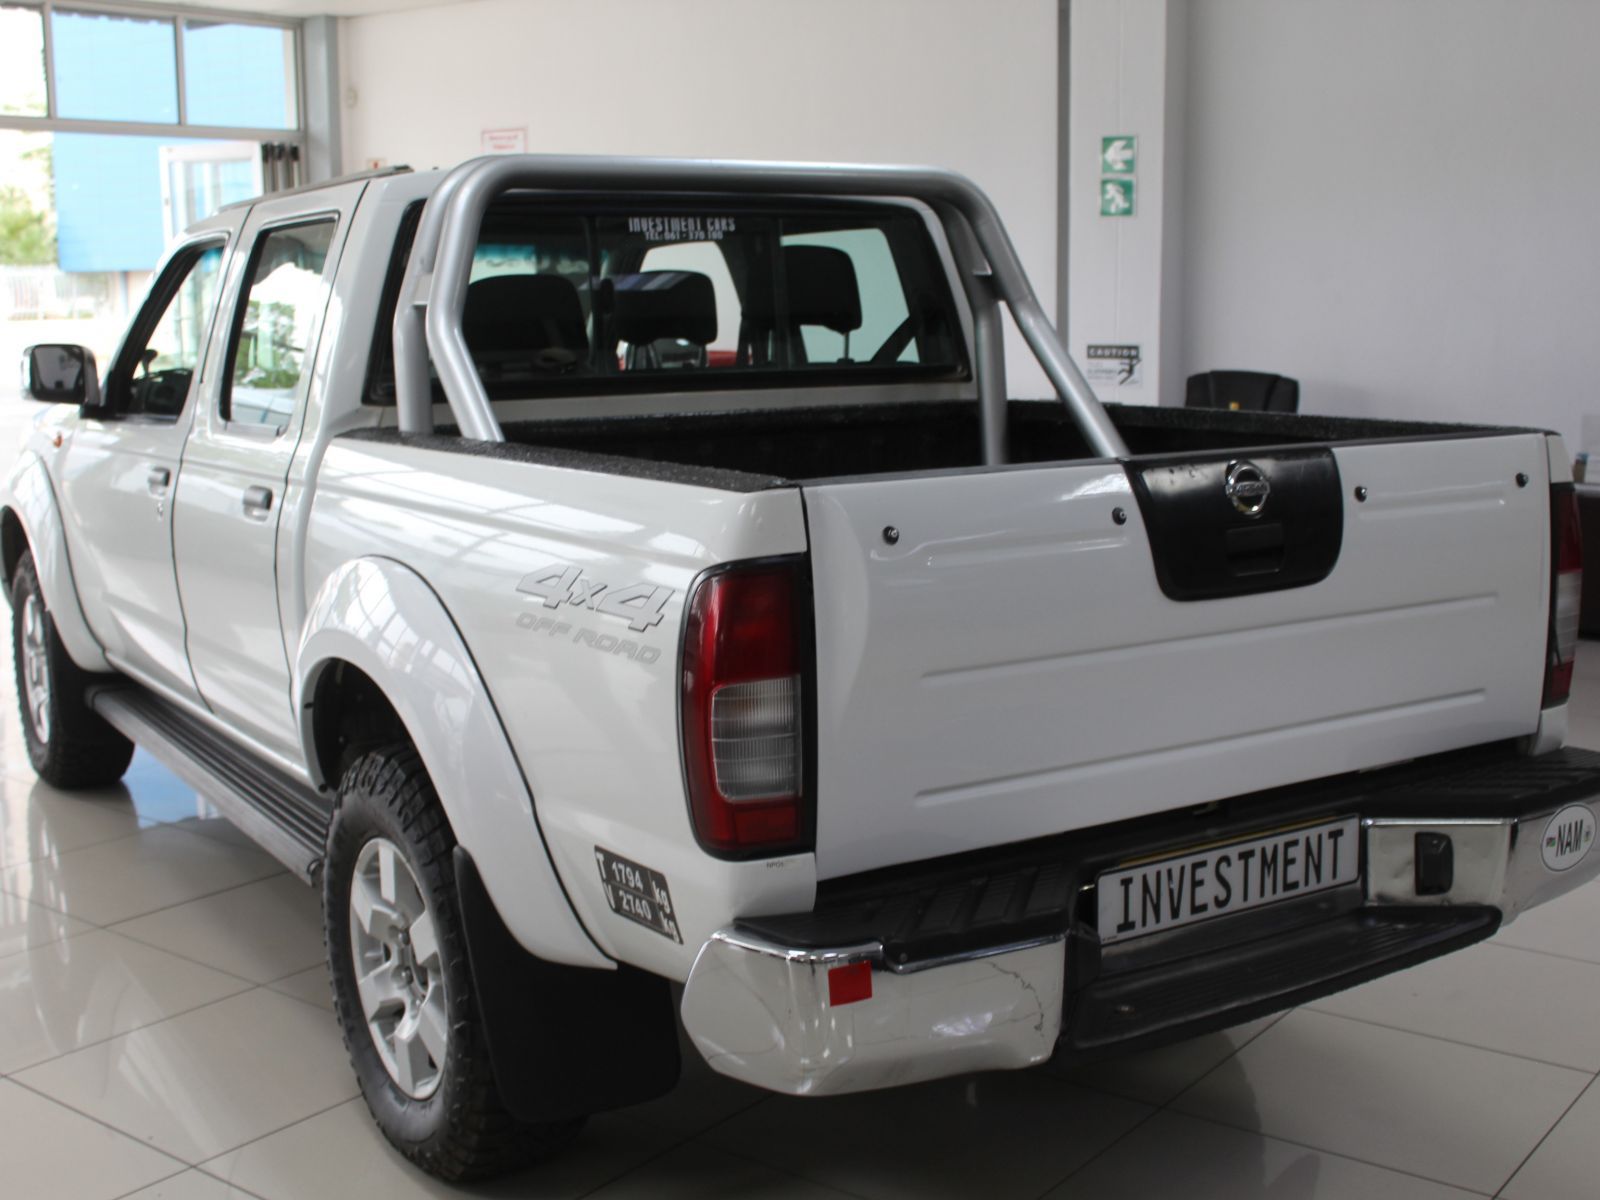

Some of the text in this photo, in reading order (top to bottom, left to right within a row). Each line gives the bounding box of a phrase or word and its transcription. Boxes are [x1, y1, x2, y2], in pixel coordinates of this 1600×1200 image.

[628, 216, 736, 232] INVESTMENT CARS
[1089, 348, 1137, 357] CAUTION
[515, 612, 662, 665] OFF ROAD
[1555, 819, 1584, 858] NAM
[596, 851, 671, 914] T 1794 kg
[1116, 828, 1344, 934] INVESTMENT
[603, 882, 616, 910] V
[619, 889, 652, 921] 2740
